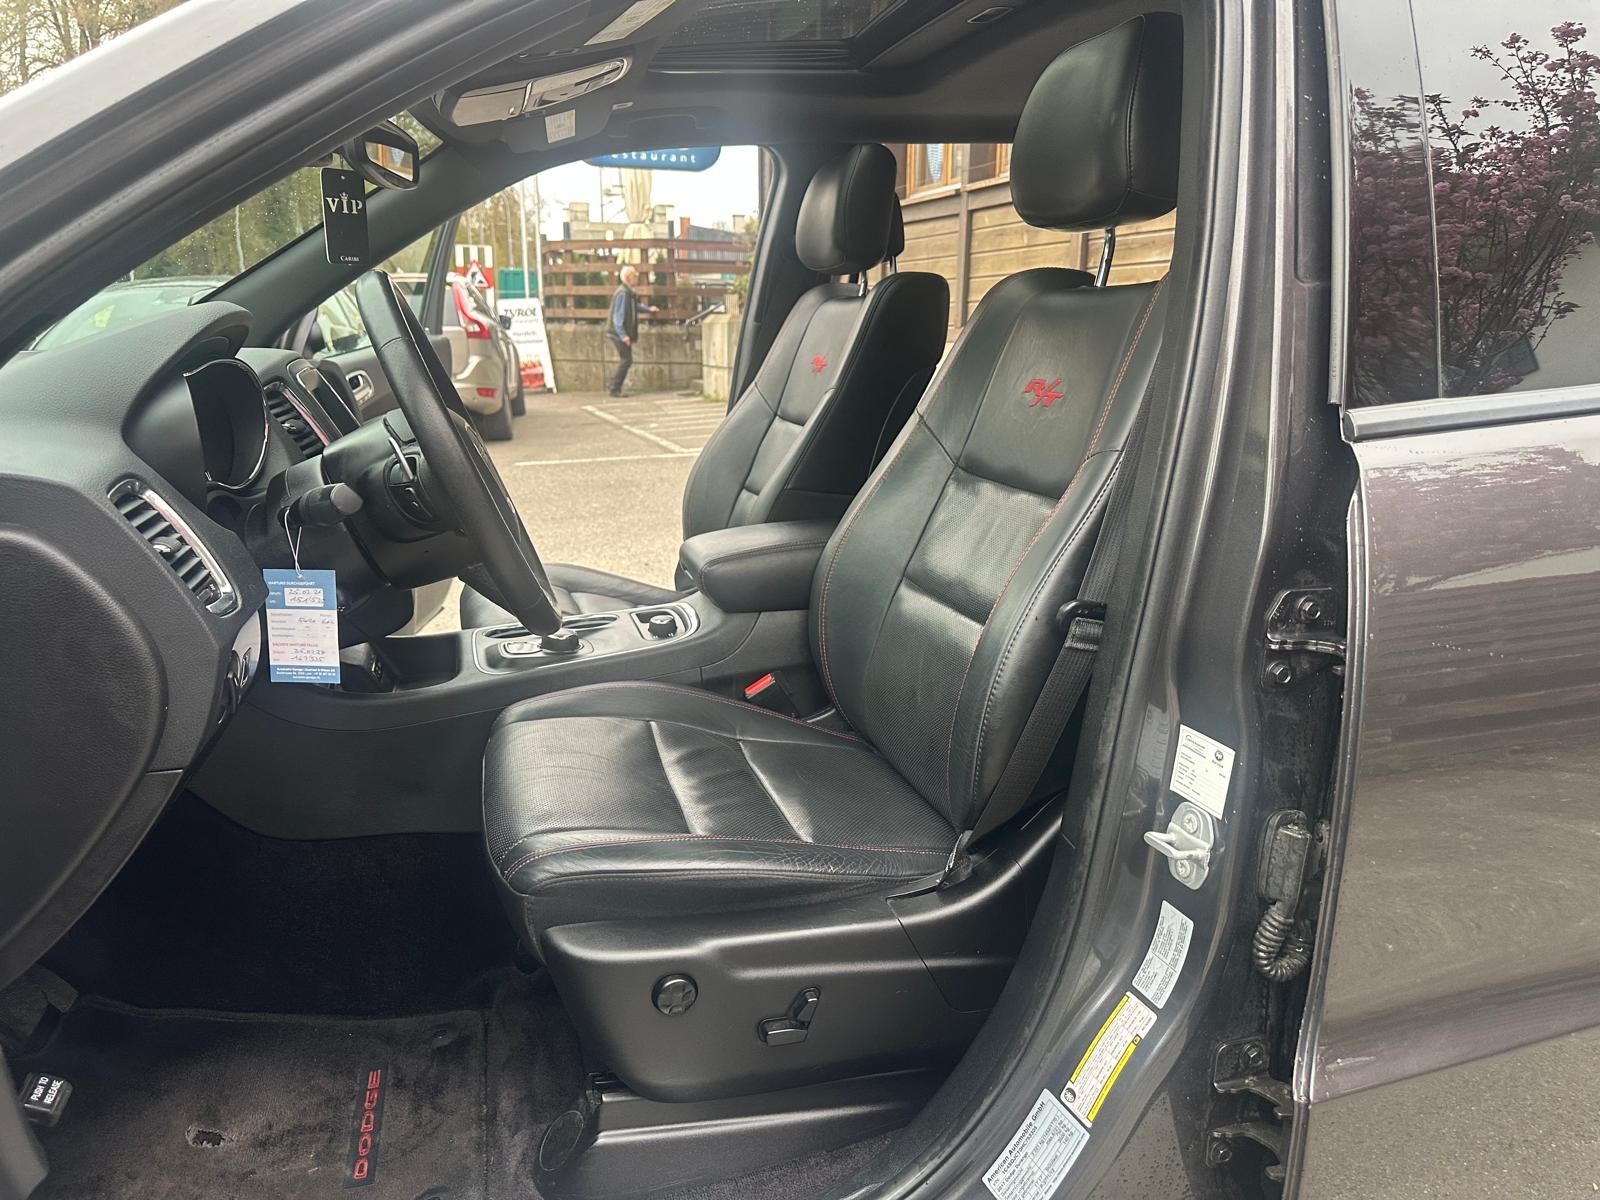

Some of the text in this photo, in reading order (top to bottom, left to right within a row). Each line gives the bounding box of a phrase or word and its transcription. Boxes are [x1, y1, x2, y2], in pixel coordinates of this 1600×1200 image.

[326, 197, 363, 214] VIP
[1024, 378, 1064, 407] R/T
[30, 1076, 49, 1101] PUSH TO
[353, 1069, 381, 1180] DODGE
[986, 1154, 1009, 1184] American
[1006, 1120, 1033, 1155] Automobile
[1029, 1100, 1046, 1121] GmbH
